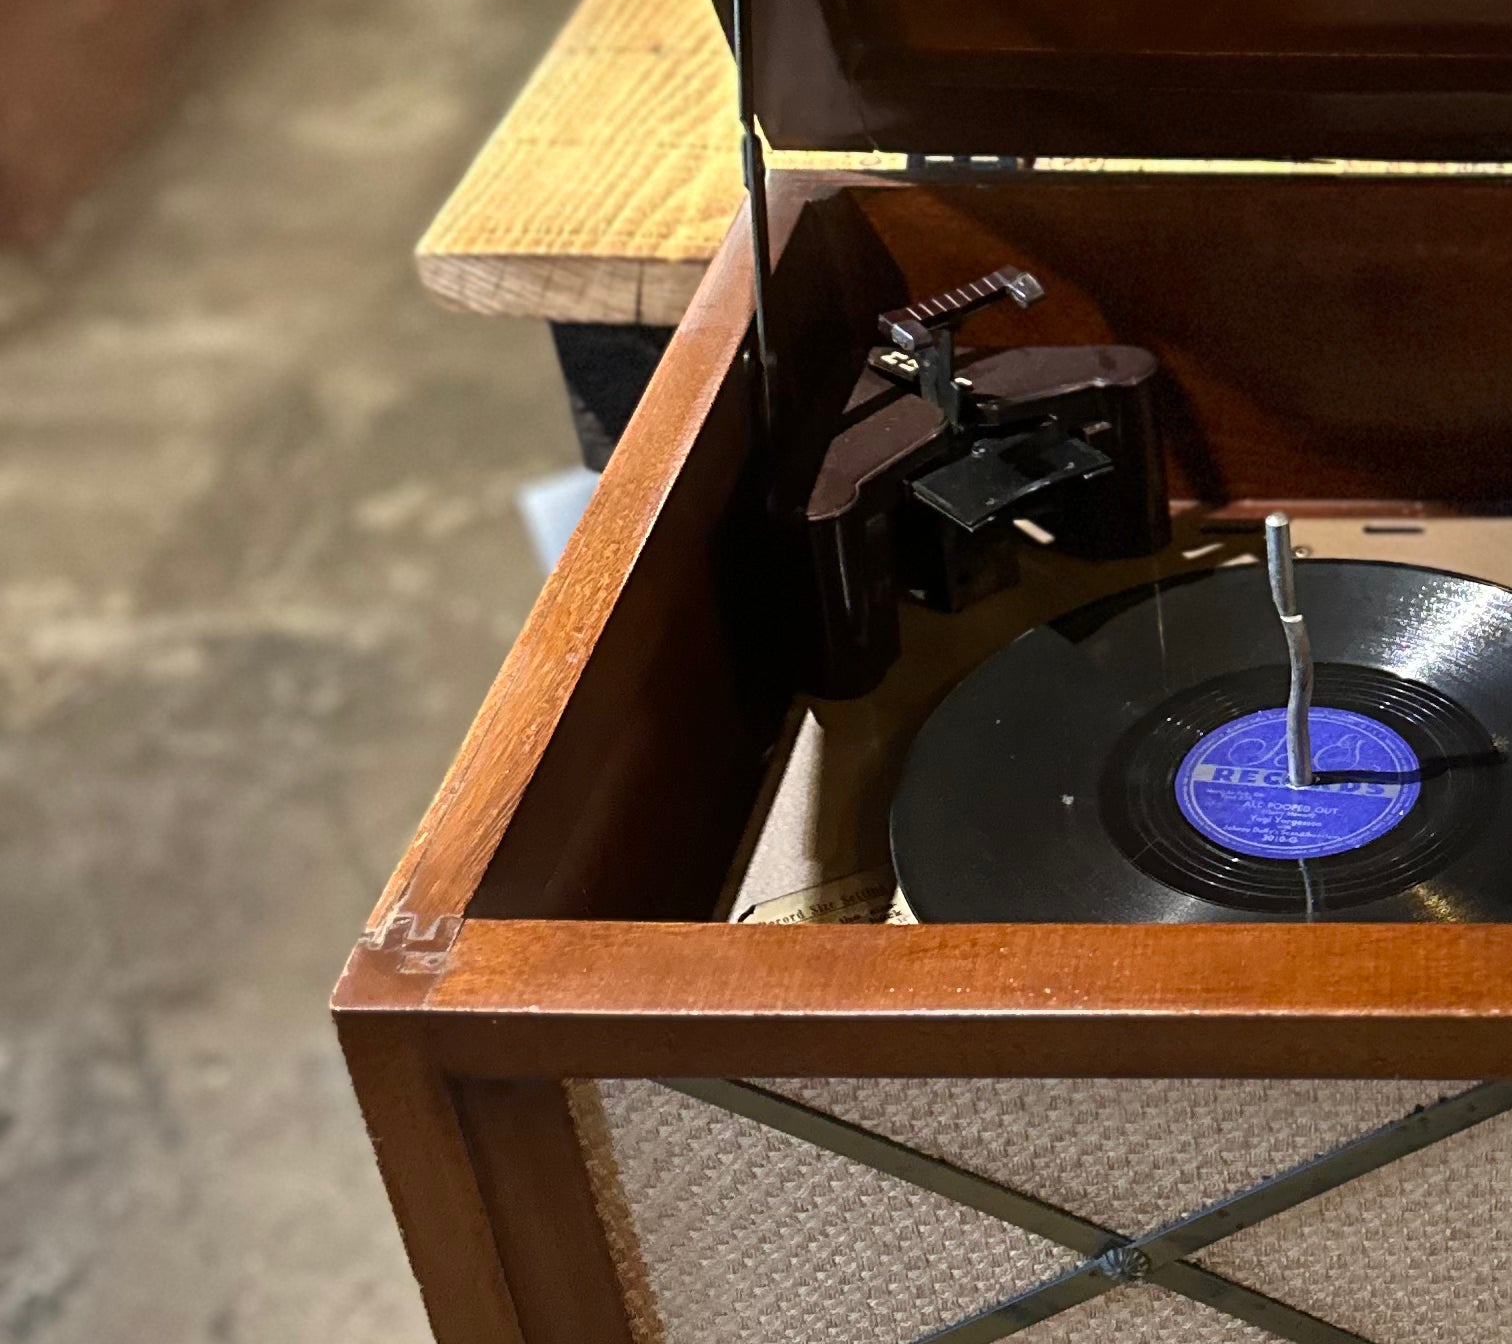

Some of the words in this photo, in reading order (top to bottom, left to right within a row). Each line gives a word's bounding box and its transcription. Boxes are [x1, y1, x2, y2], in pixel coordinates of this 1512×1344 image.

[1212, 767, 1386, 796] RECDS
[1314, 806, 1340, 814] OUT
[809, 901, 834, 918] Size
